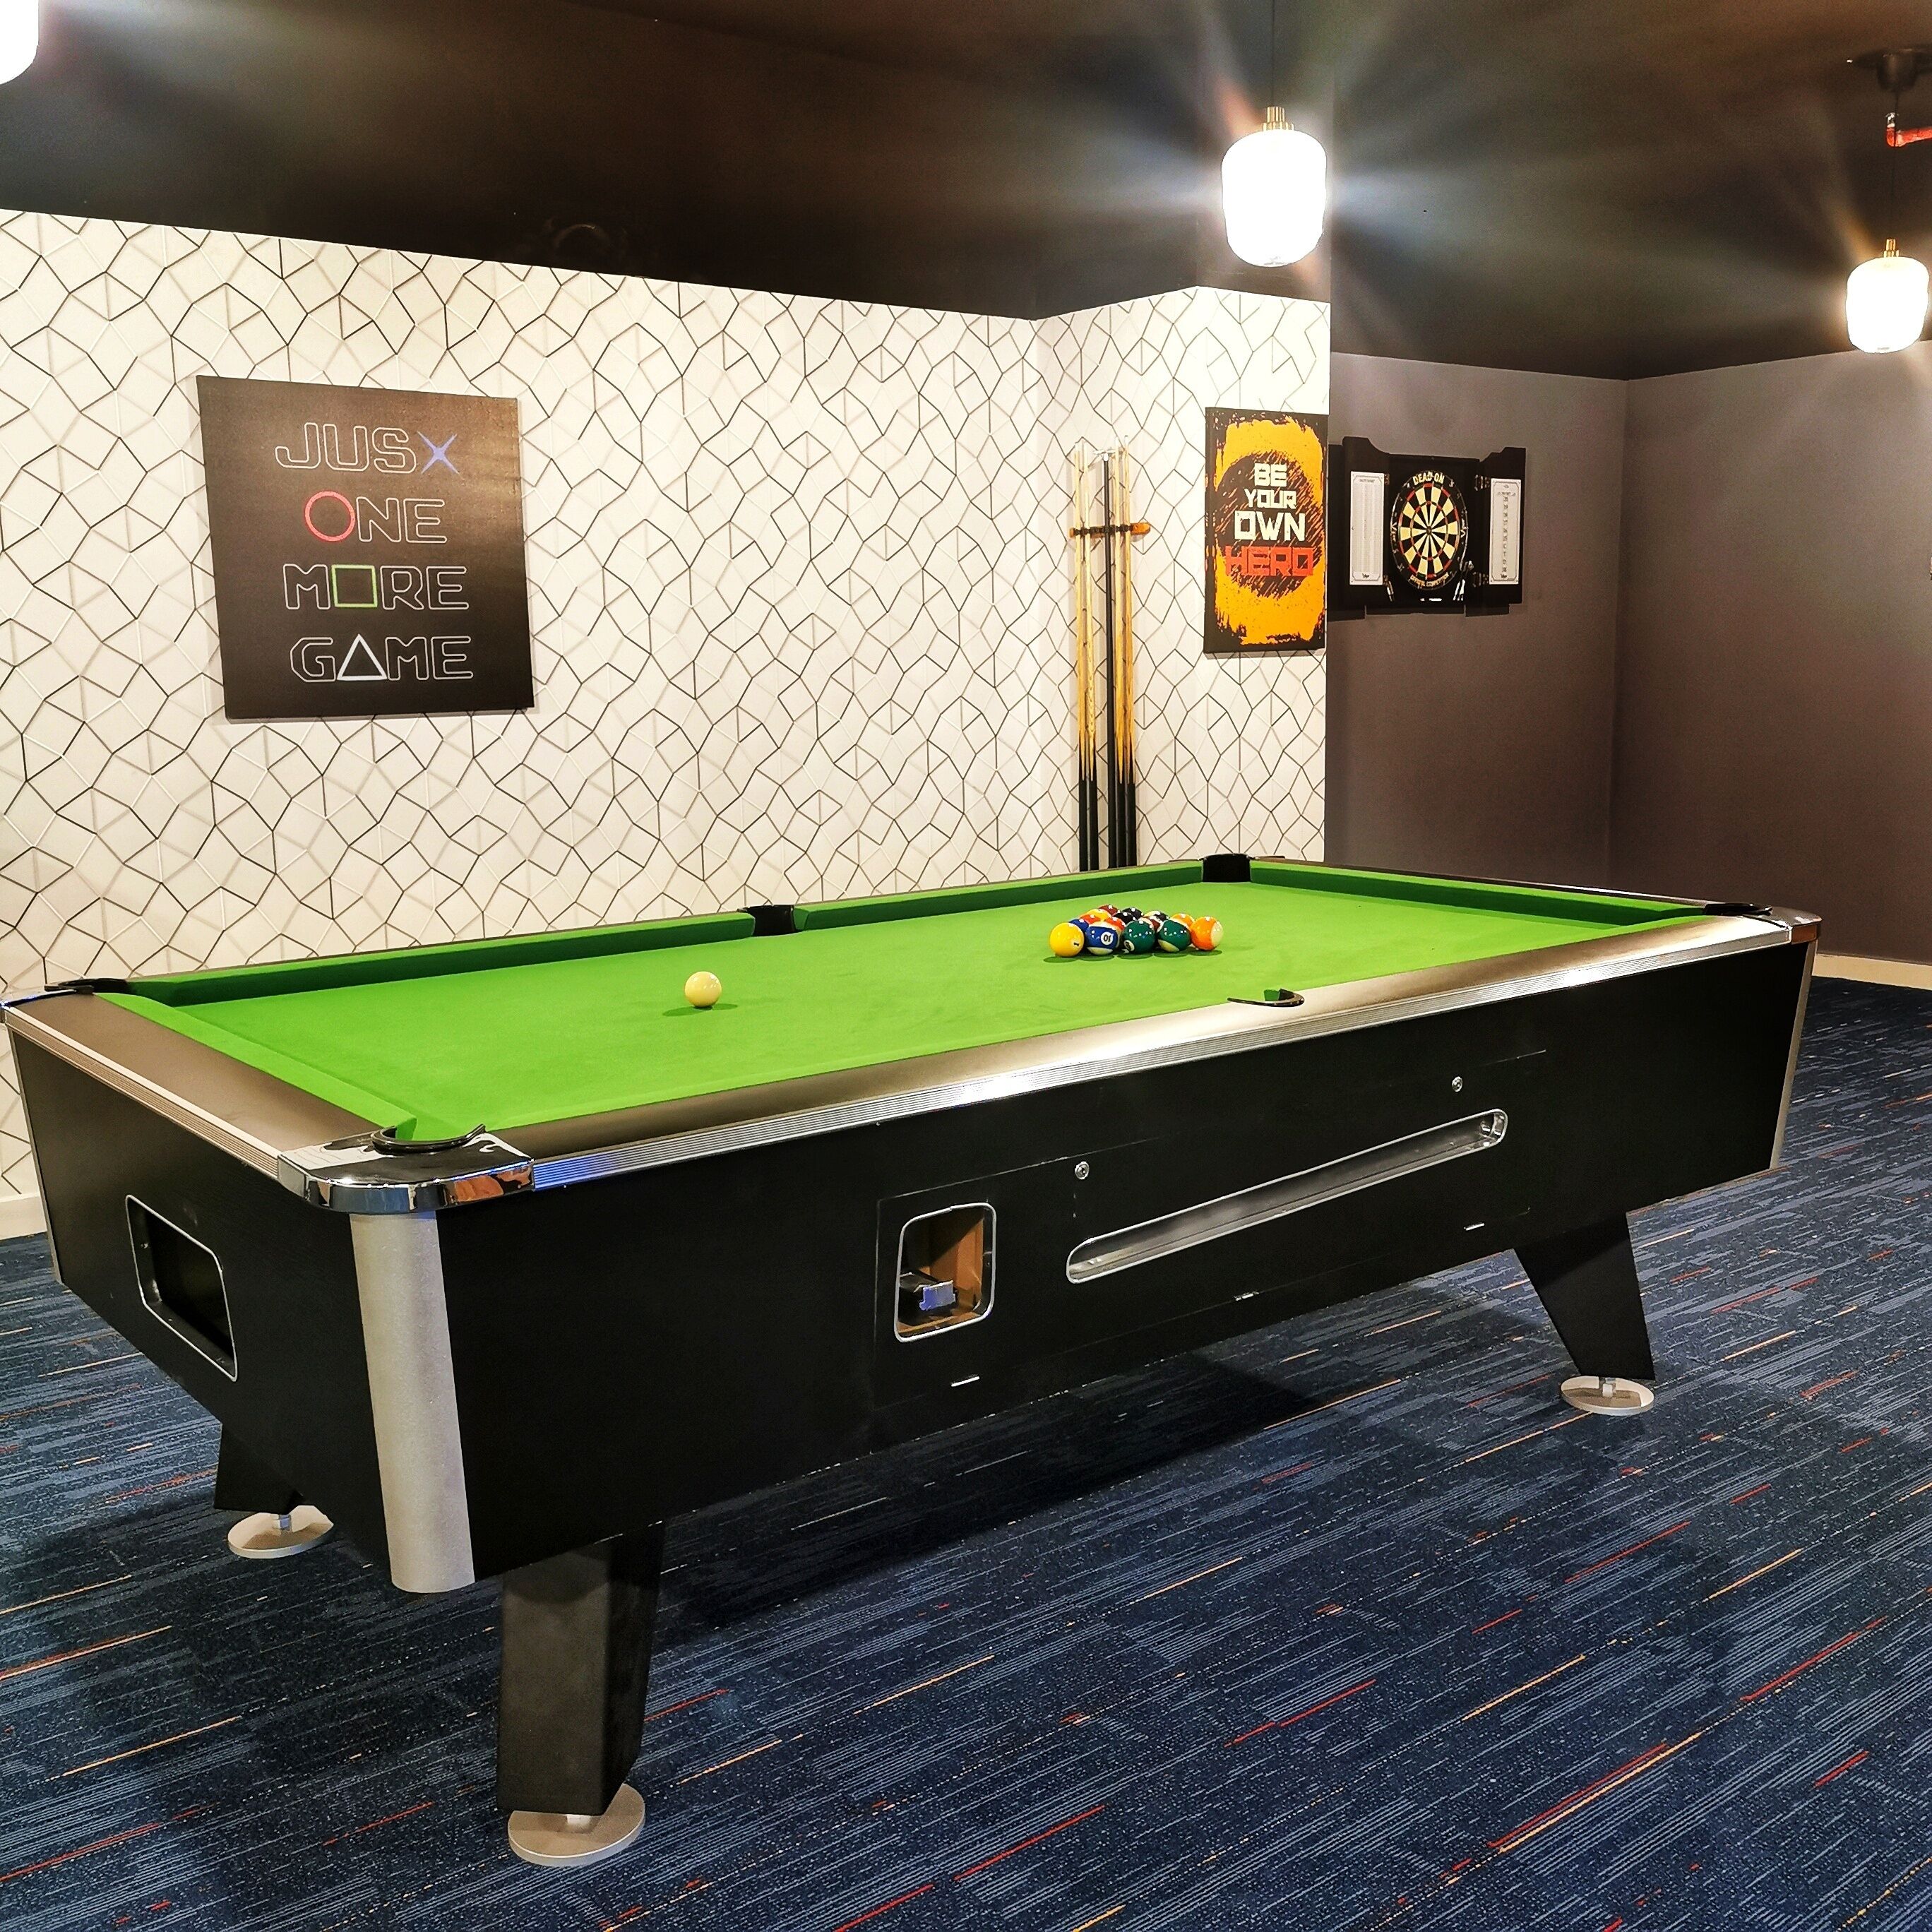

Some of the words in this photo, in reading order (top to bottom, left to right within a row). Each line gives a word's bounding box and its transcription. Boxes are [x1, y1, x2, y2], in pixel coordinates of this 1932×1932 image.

[1253, 463, 1288, 488] BE
[1412, 470, 1445, 486] DEAD-ON
[1244, 489, 1297, 510] YOUR
[304, 490, 448, 544] ONE
[1234, 510, 1306, 541] OWN
[1224, 545, 1314, 577] HERO
[282, 564, 470, 611] MORE
[290, 633, 474, 683] GAME
